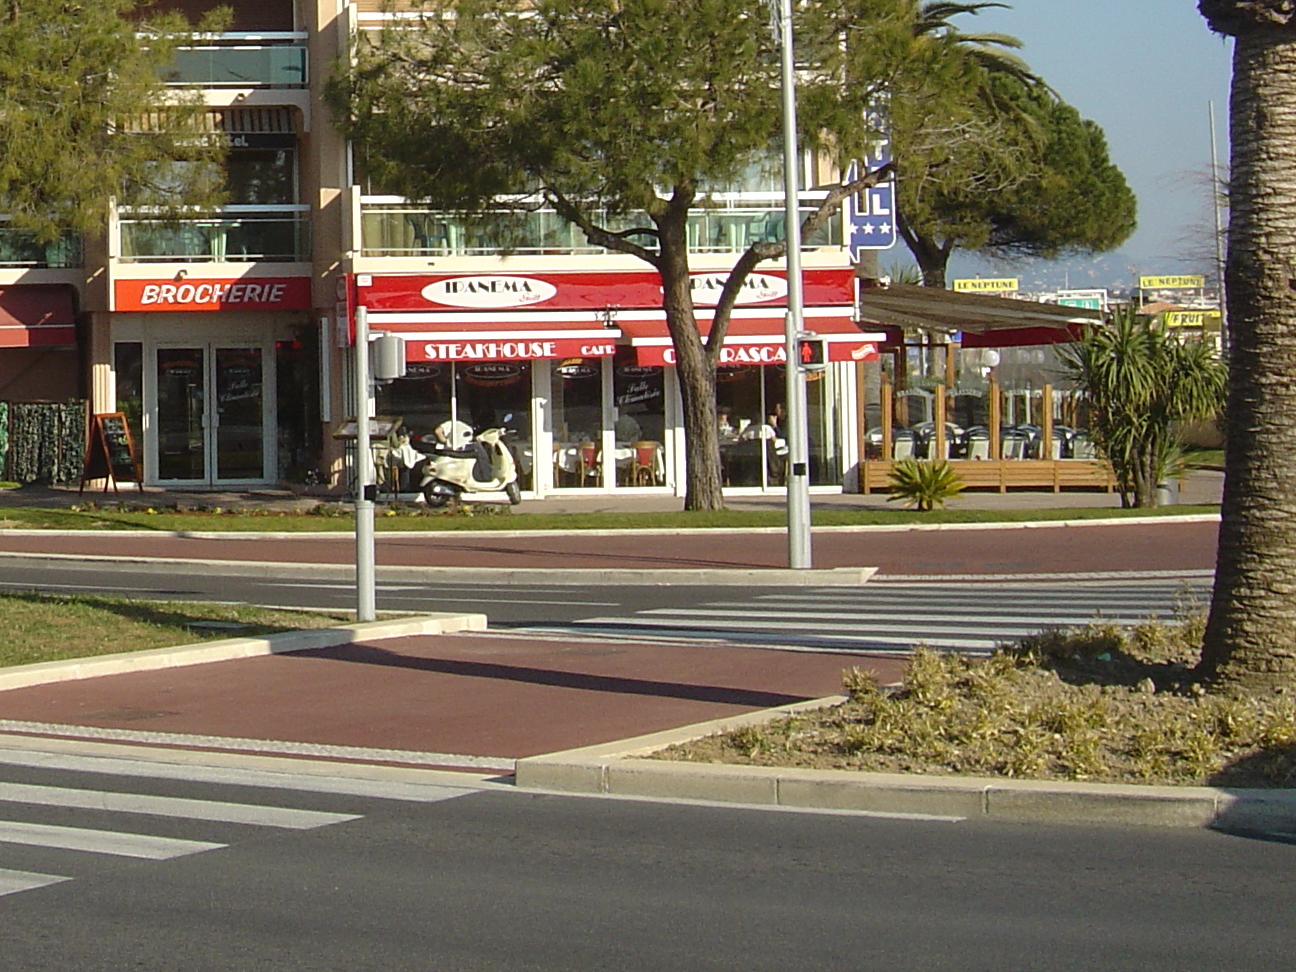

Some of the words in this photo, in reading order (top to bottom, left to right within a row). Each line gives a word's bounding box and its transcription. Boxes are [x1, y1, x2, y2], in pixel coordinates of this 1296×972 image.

[445, 280, 533, 294] IPANEMA
[957, 281, 968, 290] LE
[971, 280, 1015, 289] NEPTUNE
[141, 283, 287, 305] BROCHERIE
[424, 342, 557, 359] STEAKHOUSE
